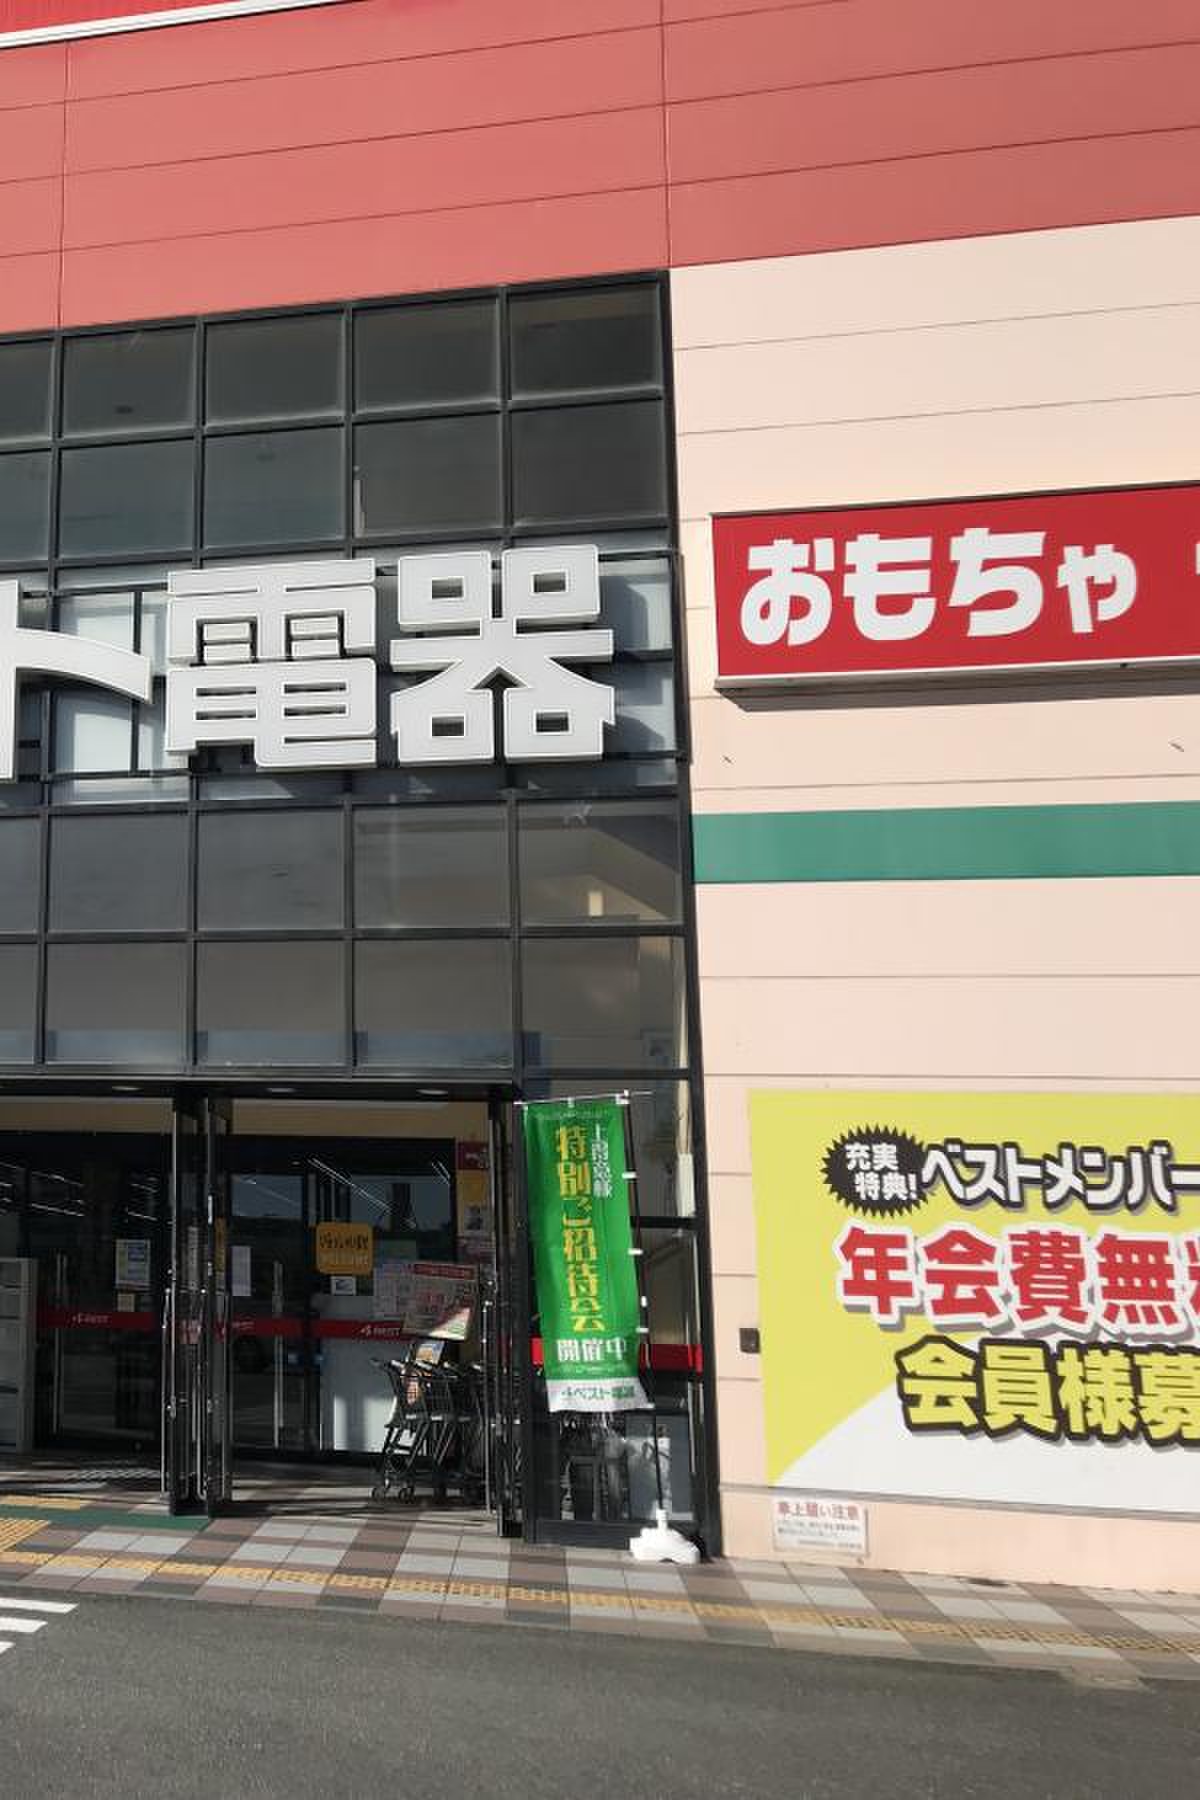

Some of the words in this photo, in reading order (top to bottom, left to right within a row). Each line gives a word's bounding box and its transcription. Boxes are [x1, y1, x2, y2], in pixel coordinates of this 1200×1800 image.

[740, 527, 1137, 646] おもちゃ
[844, 1142, 899, 1171] 充実
[840, 1226, 1200, 1330] 年会費無
[556, 1336, 628, 1362] 開催中
